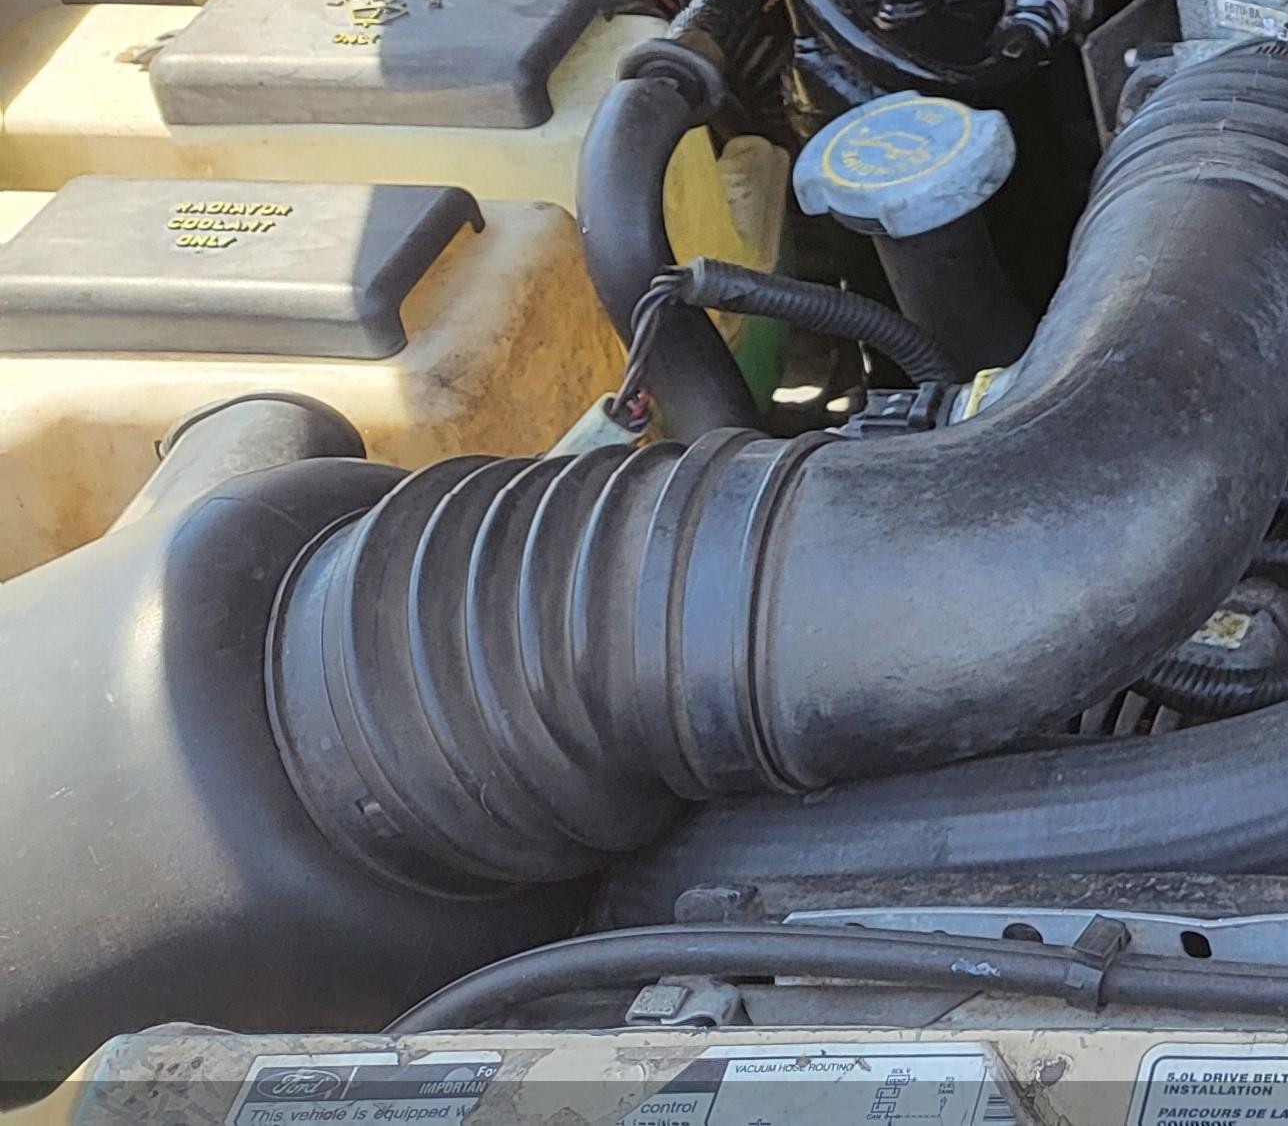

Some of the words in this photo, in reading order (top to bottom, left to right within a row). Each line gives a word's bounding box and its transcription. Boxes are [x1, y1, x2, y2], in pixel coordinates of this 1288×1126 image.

[176, 201, 293, 217] RADIATOR
[167, 217, 276, 233] COOLANT
[176, 233, 237, 248] ONLY
[735, 1063, 777, 1073] VACUUM
[272, 1073, 330, 1095] Ford
[1166, 1072, 1197, 1083] 5.0L
[1202, 1072, 1249, 1083] DRIVE
[1163, 1084, 1274, 1096] INSTALLATION
[640, 1100, 698, 1114] control
[1157, 1107, 1242, 1119] PARCOURS
[1244, 1108, 1267, 1119] DE
[250, 1109, 284, 1123] This
[289, 1106, 347, 1122] vehicle
[352, 1107, 368, 1120] is
[375, 1104, 451, 1125] equipped
